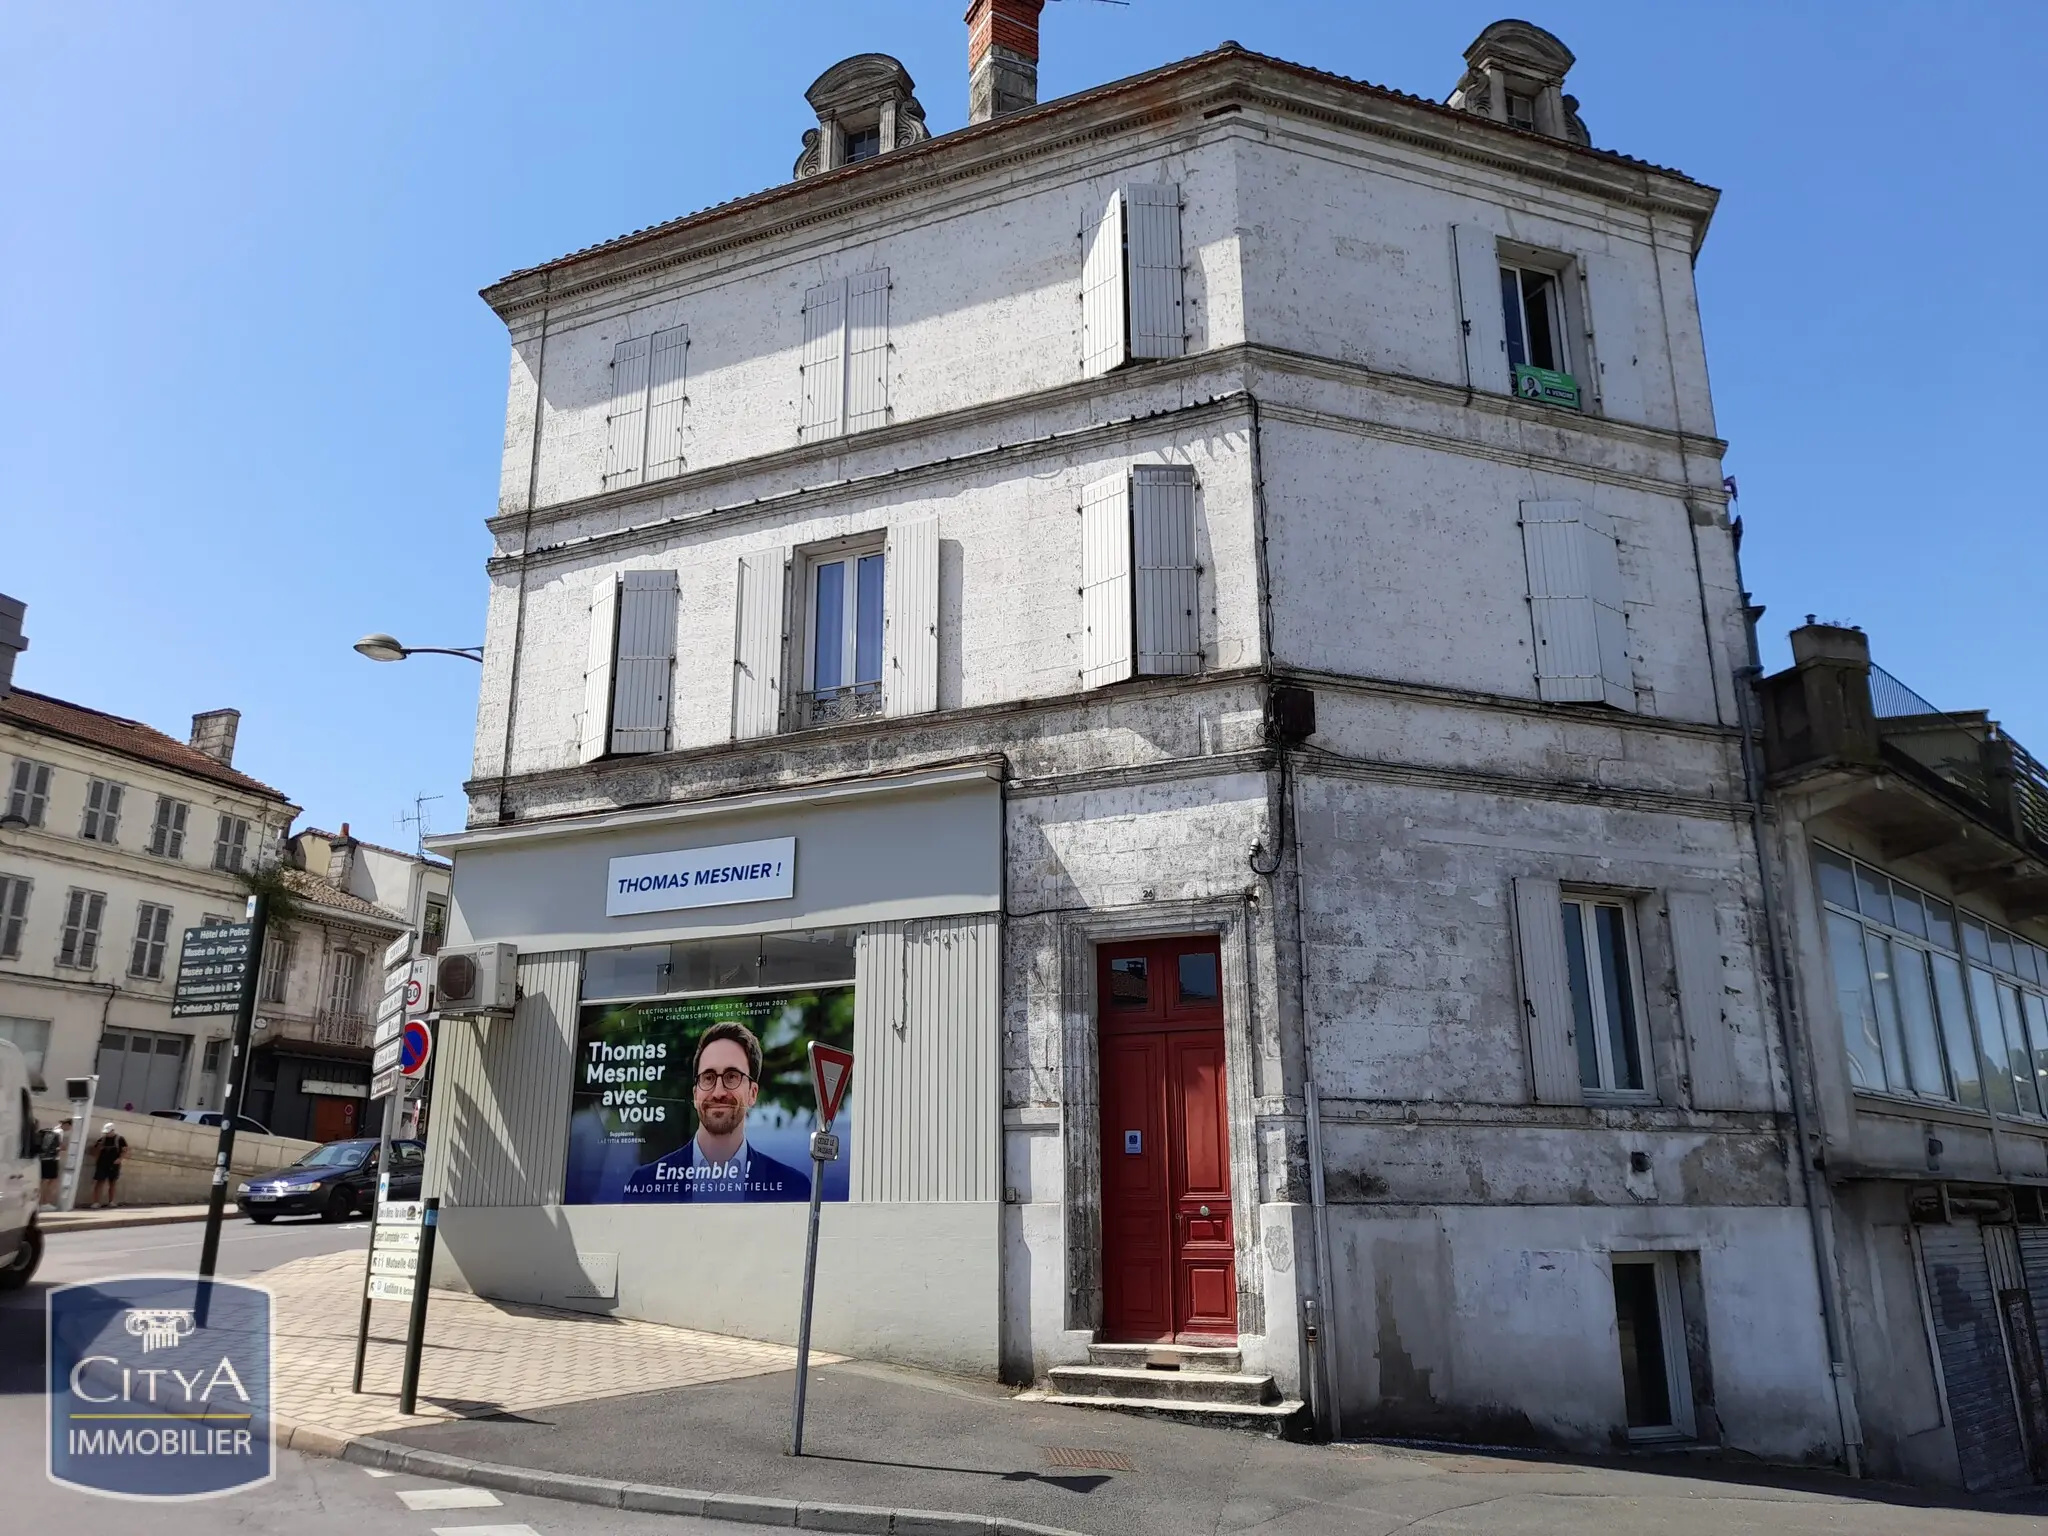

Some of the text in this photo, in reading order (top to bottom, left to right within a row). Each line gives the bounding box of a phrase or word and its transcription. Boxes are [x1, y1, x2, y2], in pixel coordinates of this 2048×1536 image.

[618, 862, 782, 894] THOMAS MESNIER !
[200, 927, 250, 939] Hôtel de Police
[184, 947, 205, 957] Musée
[216, 945, 238, 956] Papier
[181, 964, 233, 976] Musée de la BD
[407, 988, 419, 999] 30
[181, 1003, 213, 1013] Cathédrale
[221, 1001, 239, 1011] Pierre
[638, 1006, 673, 1015] ÉLECTIONS
[674, 1004, 719, 1013] LÉGISLATIVES
[665, 1011, 724, 1021] CIRCONSCRIPTION
[736, 1008, 771, 1016] CHARENTE
[588, 1041, 667, 1062] Thomas
[586, 1060, 666, 1084] Mesnier
[602, 1088, 648, 1106] avec
[619, 1106, 666, 1123] vous
[655, 1160, 752, 1180] Ensemble !
[623, 1181, 783, 1193] MAJORITÉ PRÉSIDENTIELLE
[386, 1257, 407, 1269] Mutuelle
